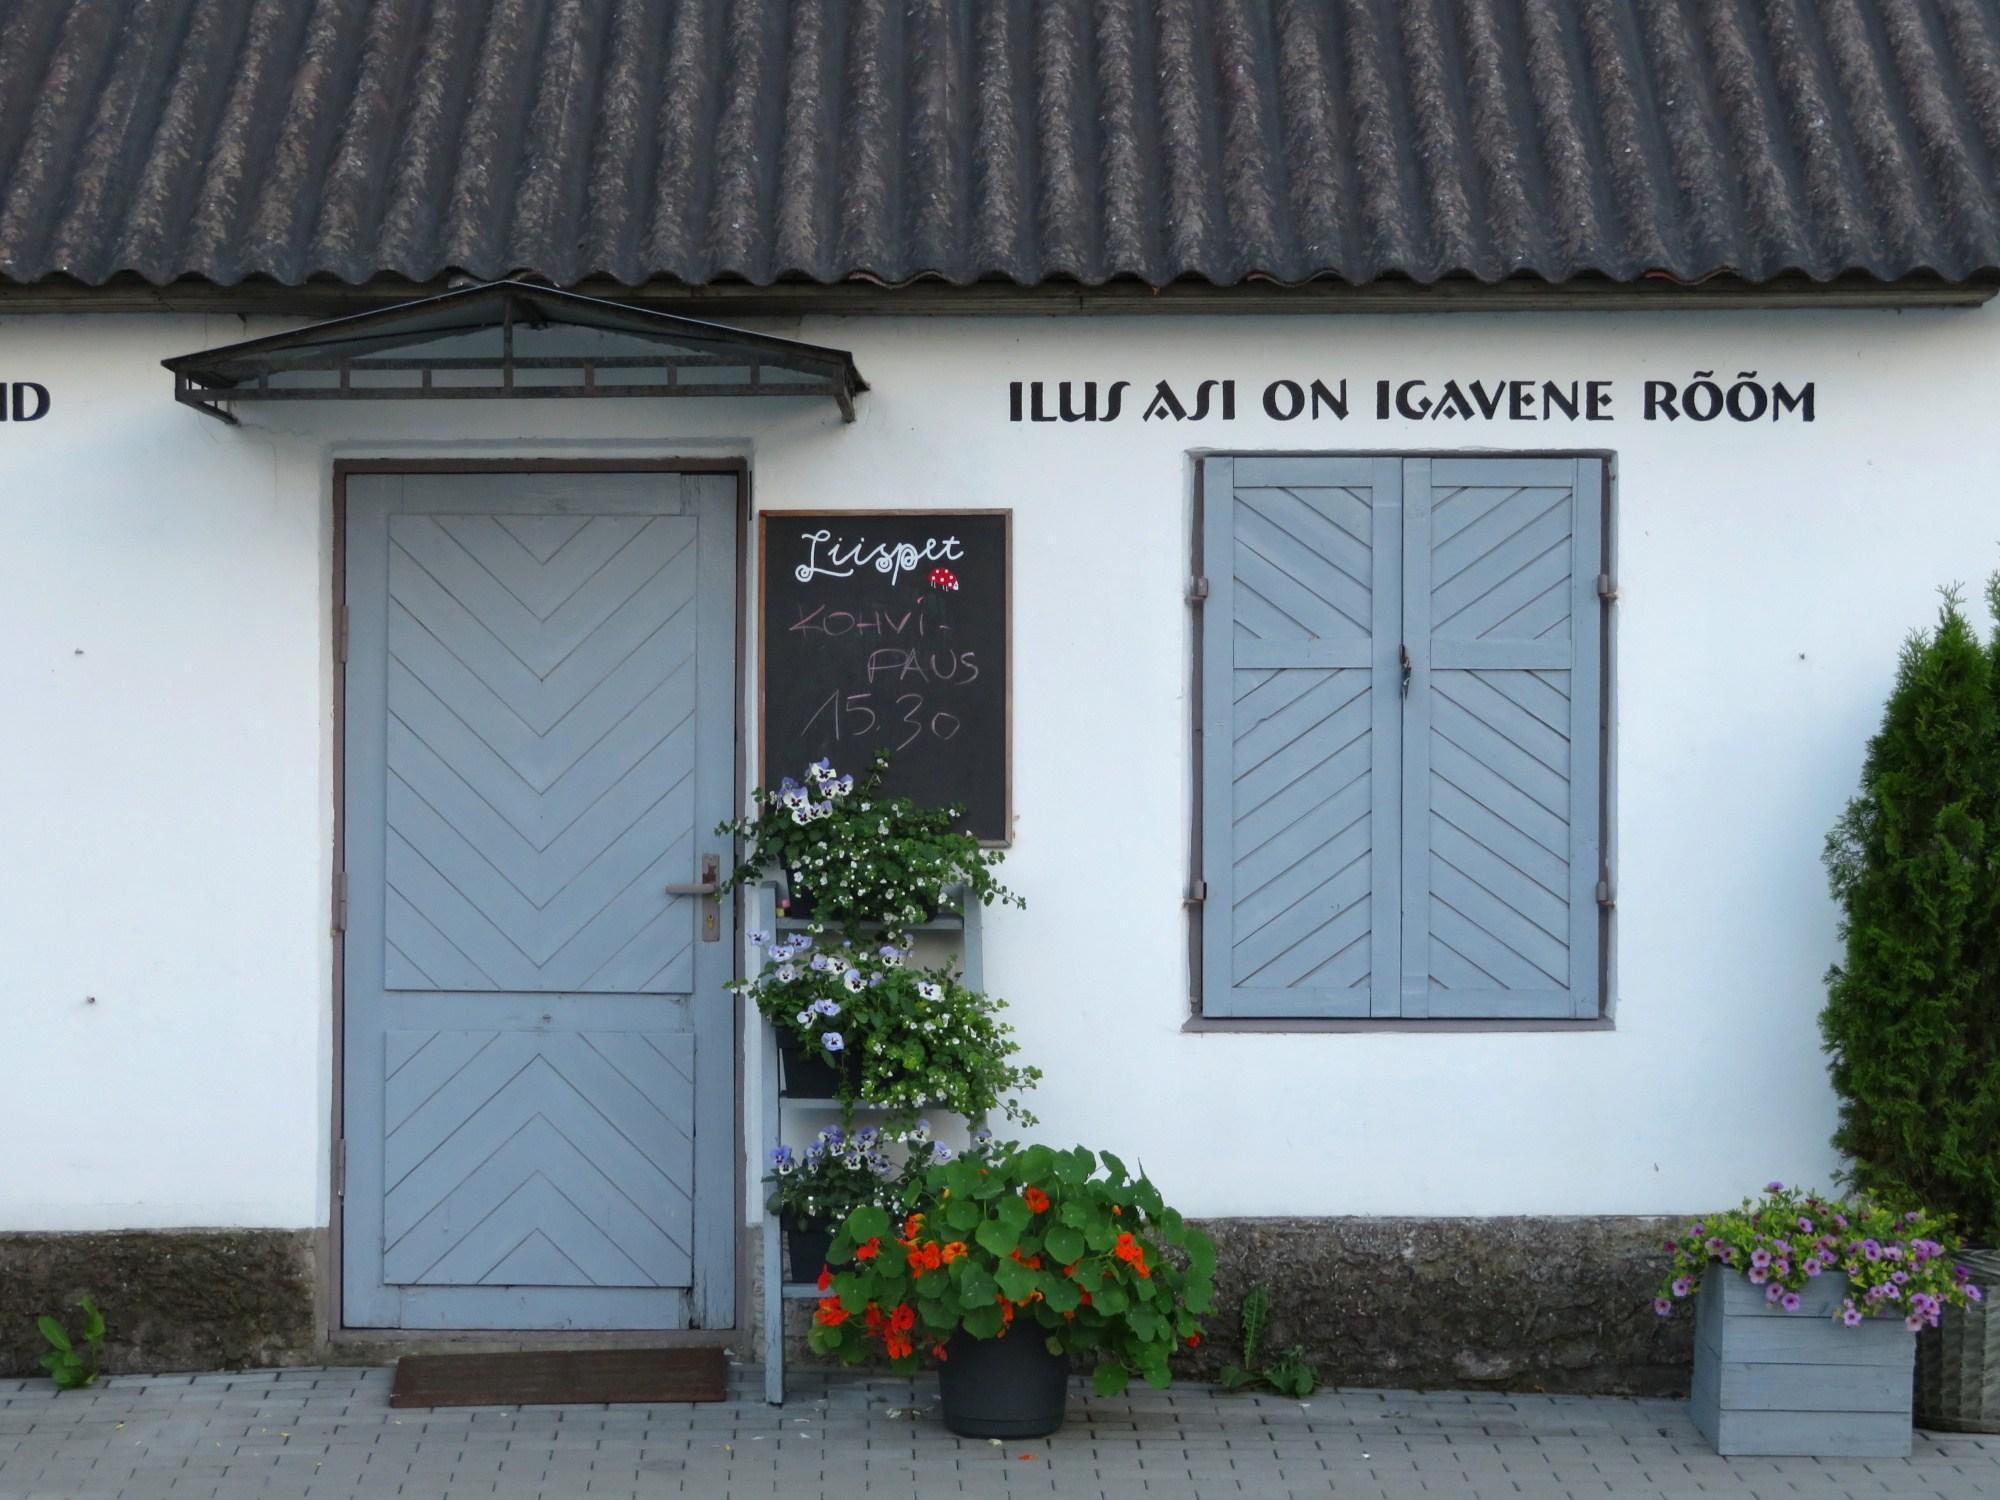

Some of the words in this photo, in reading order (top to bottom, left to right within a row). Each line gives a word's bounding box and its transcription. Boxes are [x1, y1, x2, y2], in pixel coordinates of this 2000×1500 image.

[1009, 380, 1131, 422] ILUS
[1142, 379, 1236, 422] ASI
[1262, 379, 1349, 421] ON
[1376, 379, 1614, 422] IGAVENE
[1643, 370, 1816, 423] RÕÕM
[795, 530, 964, 586] Liispet
[867, 648, 979, 685] PAUS
